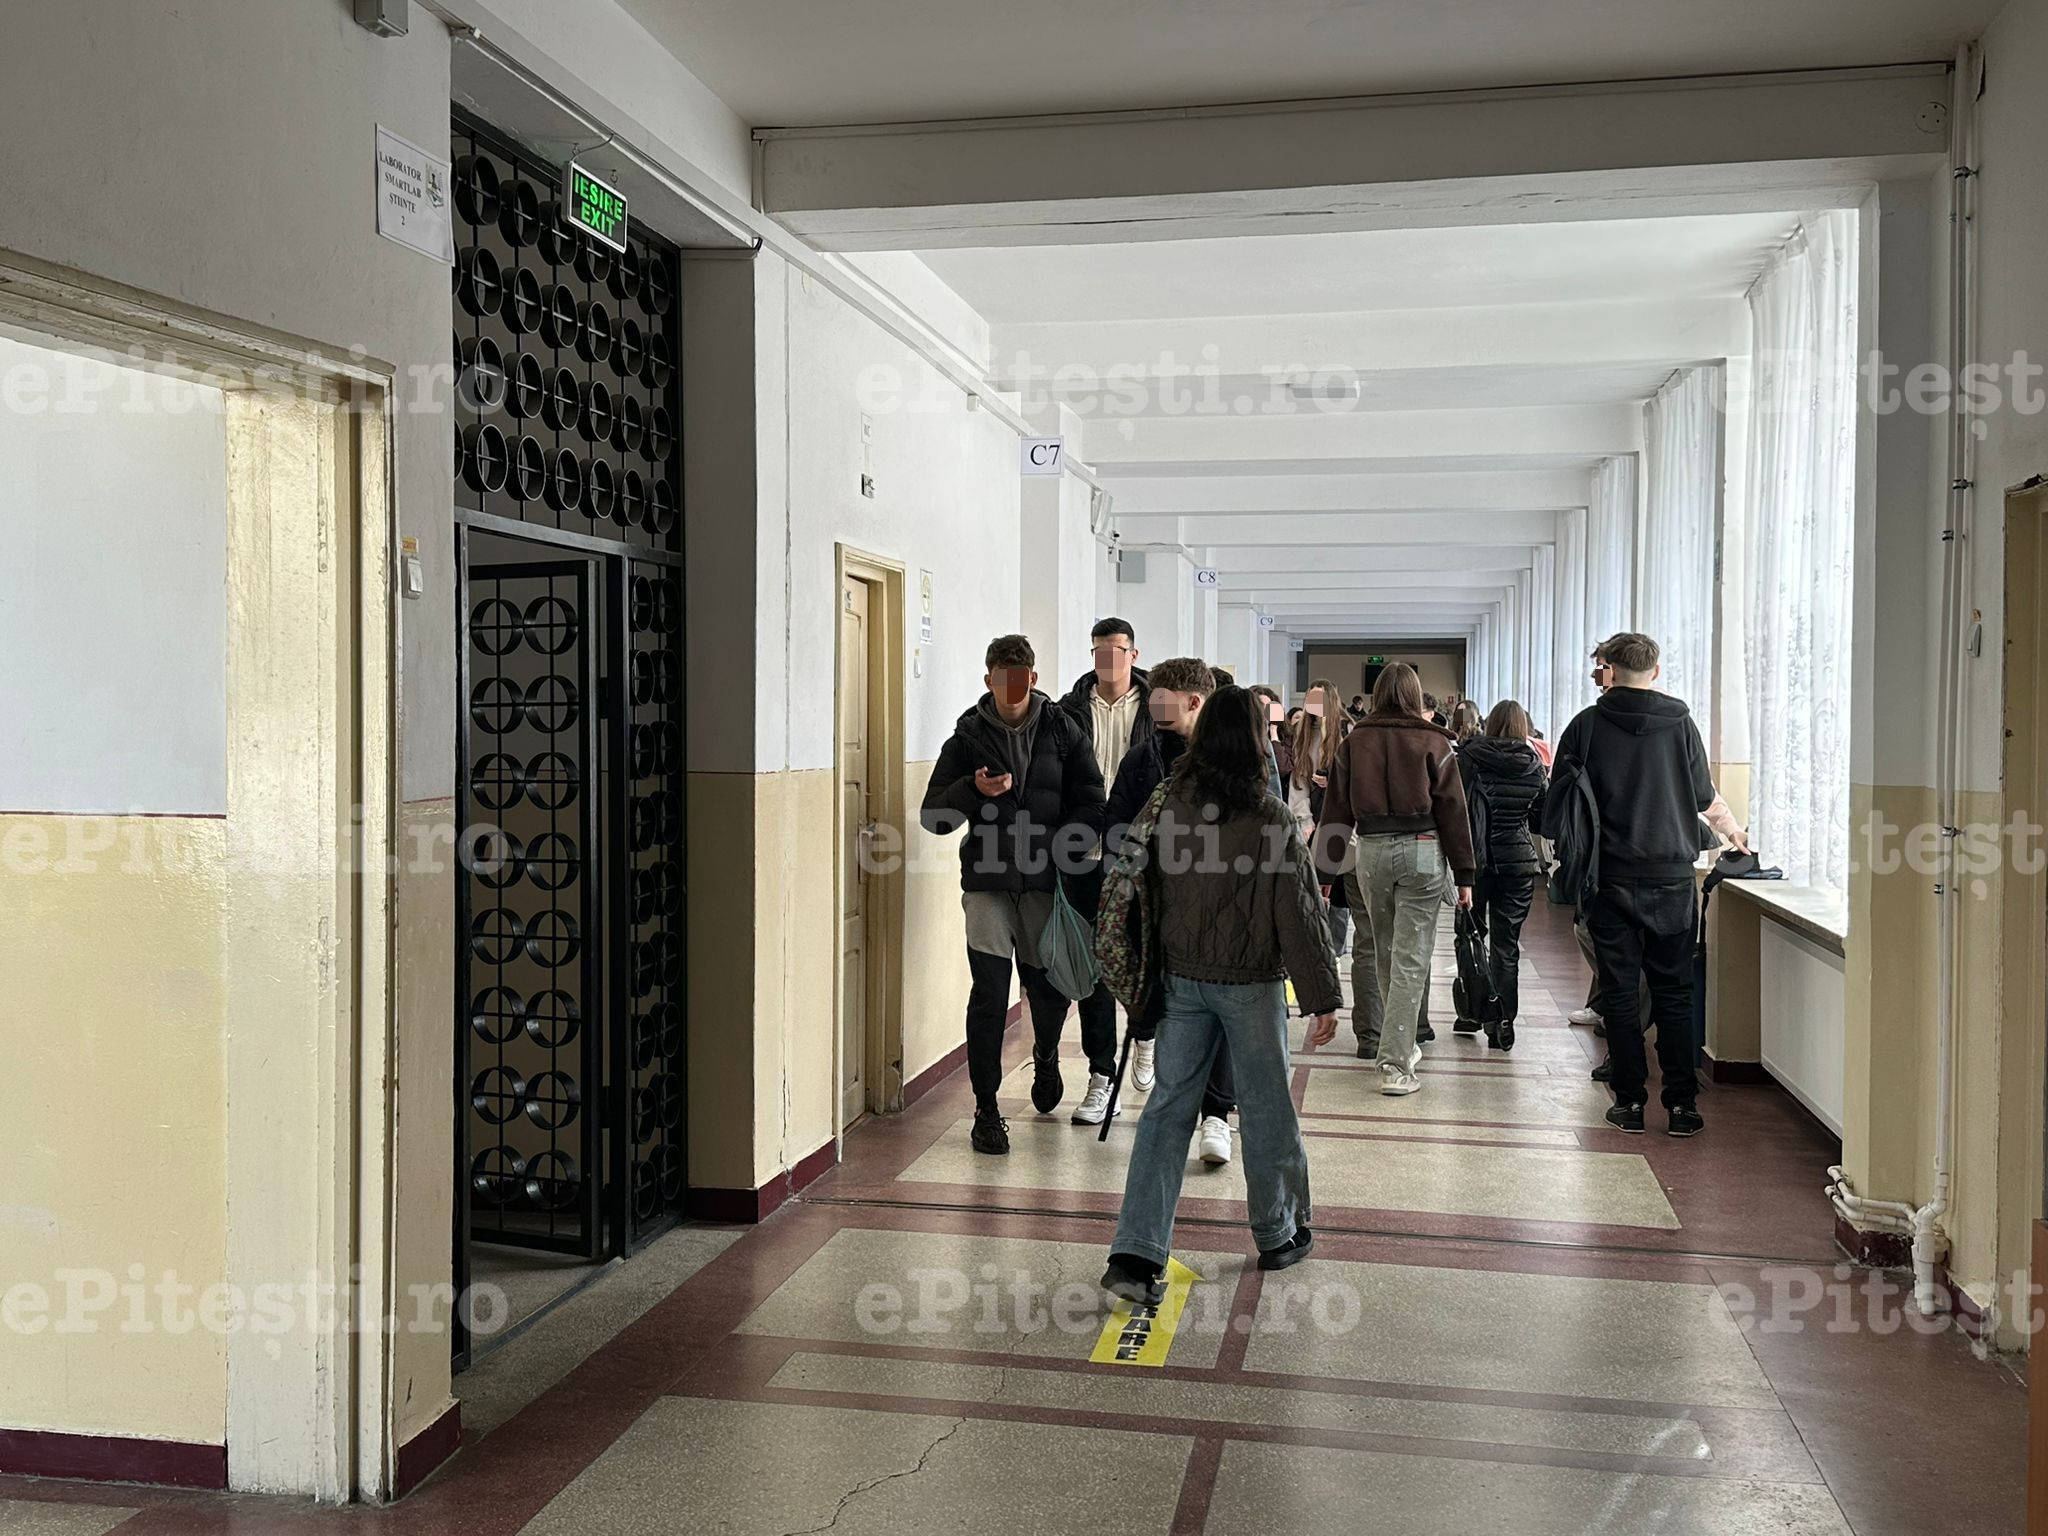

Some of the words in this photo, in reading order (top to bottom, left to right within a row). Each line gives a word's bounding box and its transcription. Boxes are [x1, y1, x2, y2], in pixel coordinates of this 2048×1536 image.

[379, 151, 422, 181] LABORATOR
[385, 171, 422, 198] SMARTLAB
[575, 173, 623, 221] IESIRE
[401, 215, 406, 226] 2
[581, 201, 615, 237] EXIT
[1030, 444, 1060, 466] C7
[1197, 570, 1216, 583] C8
[1260, 616, 1274, 626] C9
